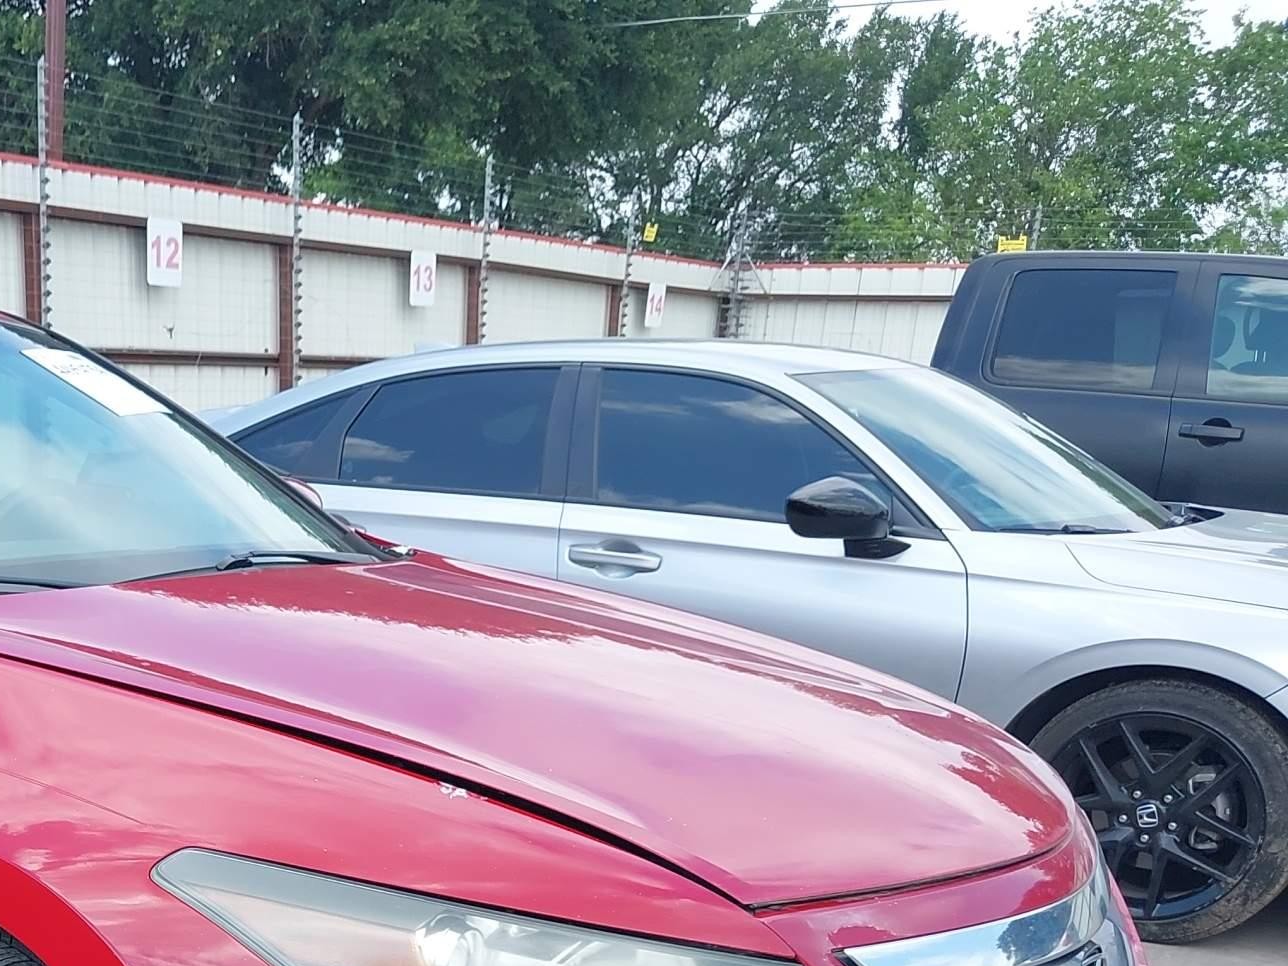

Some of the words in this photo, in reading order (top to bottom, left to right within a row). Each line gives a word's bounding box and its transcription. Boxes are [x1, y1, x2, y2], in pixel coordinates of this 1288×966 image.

[151, 235, 179, 269] 12
[413, 264, 433, 292] 13
[649, 293, 663, 316] 14
